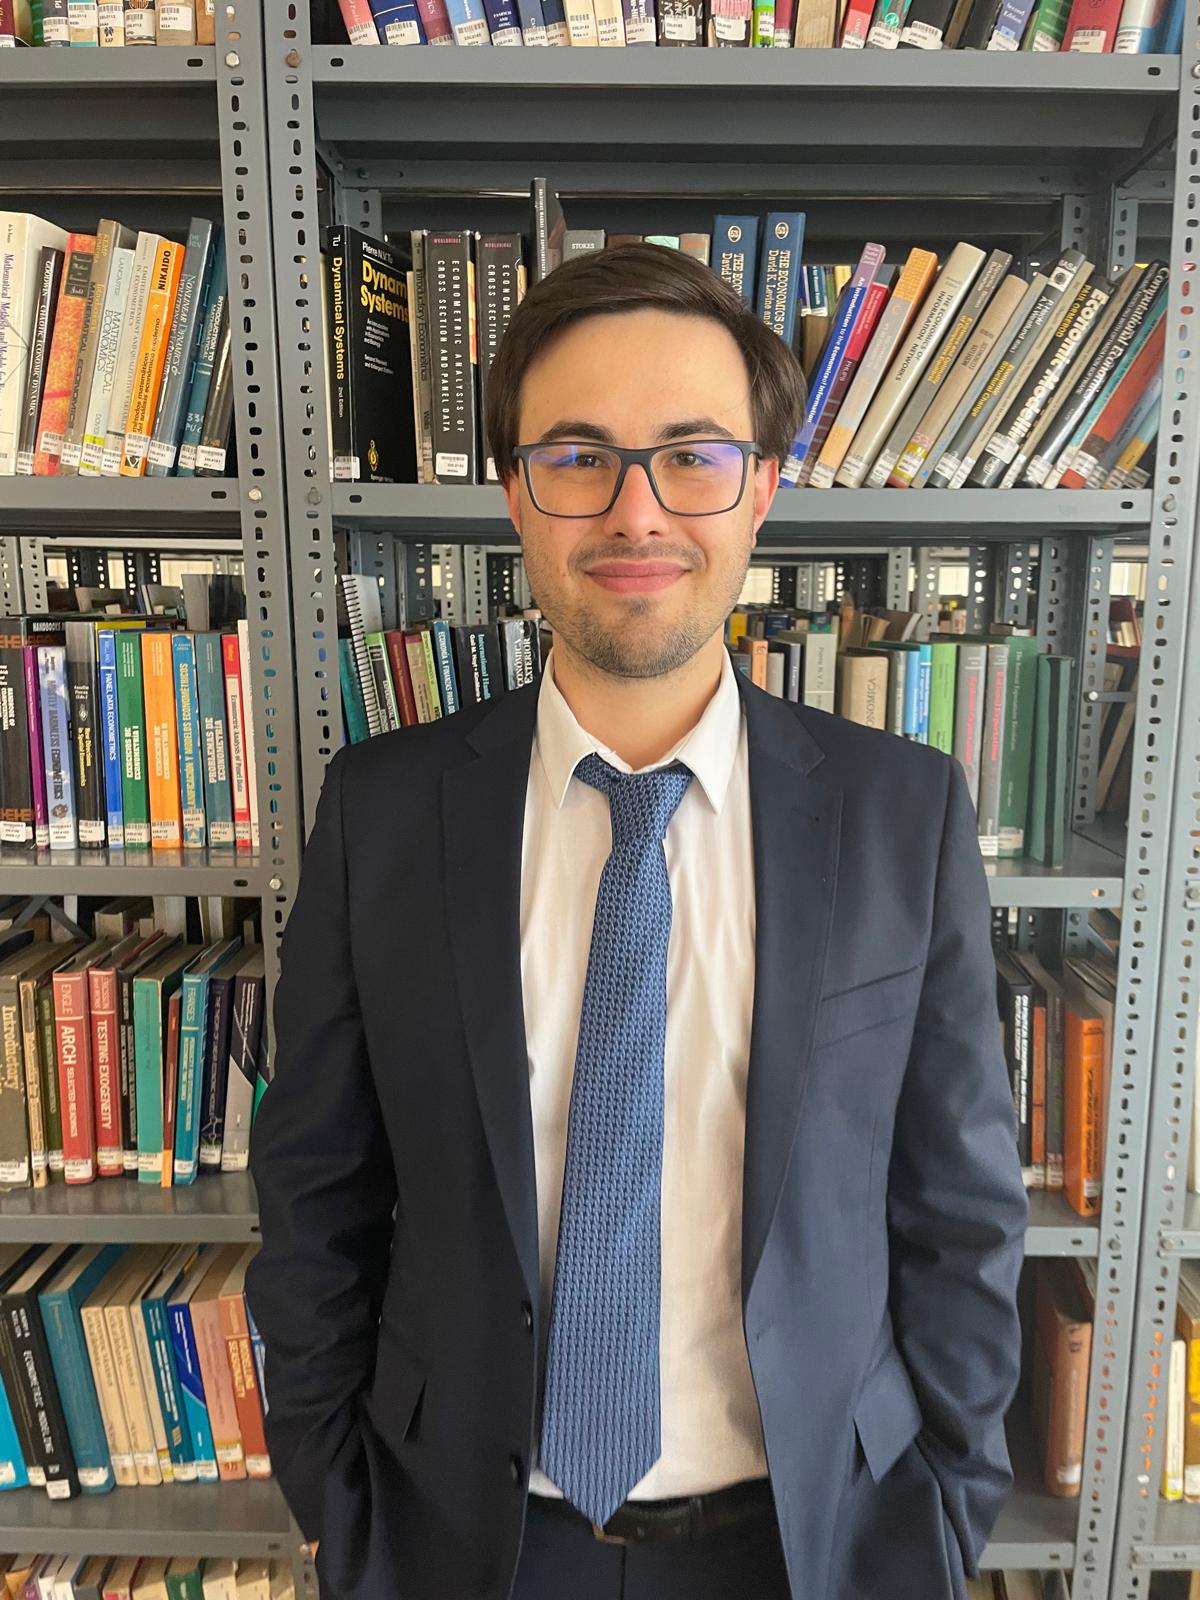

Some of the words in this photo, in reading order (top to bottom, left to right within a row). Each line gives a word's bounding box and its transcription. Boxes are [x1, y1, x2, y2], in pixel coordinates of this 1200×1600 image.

[332, 233, 340, 247] Tu
[362, 241, 378, 257] Pierre
[778, 249, 789, 269] THE
[1, 253, 14, 298] Mathematical
[41, 259, 53, 297] GOODWIN
[157, 249, 171, 290] NIKAIDO
[437, 259, 446, 292] CROSS
[721, 252, 732, 275] David
[732, 252, 744, 271] THE
[766, 249, 779, 272] David
[766, 273, 776, 283] K.
[179, 273, 196, 322] NONLINEAR
[332, 257, 344, 324] Dynamical
[415, 268, 426, 320] Introductory
[487, 264, 496, 296] CROSS
[762, 284, 775, 310] Levine
[772, 269, 789, 322] ECONOMICS
[857, 276, 865, 287] An
[942, 292, 953, 306] THE
[1076, 283, 1093, 303] PAUL
[37, 303, 48, 336] CHAOTIC
[78, 280, 95, 353] MATHEMATICAL
[360, 285, 409, 322] Systems
[438, 298, 447, 342] SECTION
[450, 259, 463, 345] ECONOMETRIC
[842, 286, 862, 327] Introduction
[916, 288, 946, 341] INFORMATION
[1053, 301, 1083, 339] ORMEROD
[1116, 265, 1172, 346] Computational
[96, 309, 114, 372] ECONOMICS
[209, 294, 224, 349] INTRODUCTION
[487, 302, 496, 346] SECTION
[773, 323, 783, 336] OF
[919, 307, 946, 350] ECONOMICS
[1047, 287, 1110, 373] Economic
[32, 338, 44, 376] ECONOMIC
[101, 310, 122, 394] MATHEMATICAL
[172, 323, 188, 364] DYNAMICS
[207, 350, 214, 362] TO
[334, 325, 346, 379] Systems
[418, 321, 430, 381] Econometrics
[439, 348, 448, 367] AND
[822, 344, 840, 378] Economics
[894, 341, 918, 382] NETWORKS
[914, 349, 925, 362] OF
[136, 352, 150, 399] matemáticos
[143, 352, 155, 393] económico
[440, 372, 449, 403] PANEL
[454, 352, 464, 411] ANALYSIS
[1081, 344, 1124, 405] Economics
[27, 378, 40, 416] DYNAMICS
[67, 357, 83, 429] ECONOMICS
[806, 384, 825, 423] Information
[441, 407, 450, 431] DATA
[456, 417, 464, 431] OF
[477, 633, 488, 676] International
[523, 637, 533, 684] EXTERIOR
[47, 680, 57, 710] MOSTLY
[104, 672, 113, 694] PANEL
[442, 664, 452, 690] FINANZAS
[106, 693, 114, 711] DATA
[230, 694, 239, 729] Econometric
[446, 690, 454, 705] PARA
[9, 719, 16, 727] OF
[48, 709, 60, 747] HARMLESS
[83, 727, 91, 739] New
[106, 711, 116, 761] ECONOMETRICS
[182, 721, 193, 754] MODELOS
[204, 716, 213, 729] DE
[205, 730, 218, 783] PROBLEMAS
[232, 730, 241, 754] Analysis
[50, 748, 63, 800] ECONOMETRICS
[61, 982, 74, 1015] ENGLE
[0, 1003, 22, 1090] Introductory
[59, 1024, 78, 1066] ARCH
[96, 1019, 109, 1063] TESTING
[98, 1063, 112, 1130] EXOGENEITY
